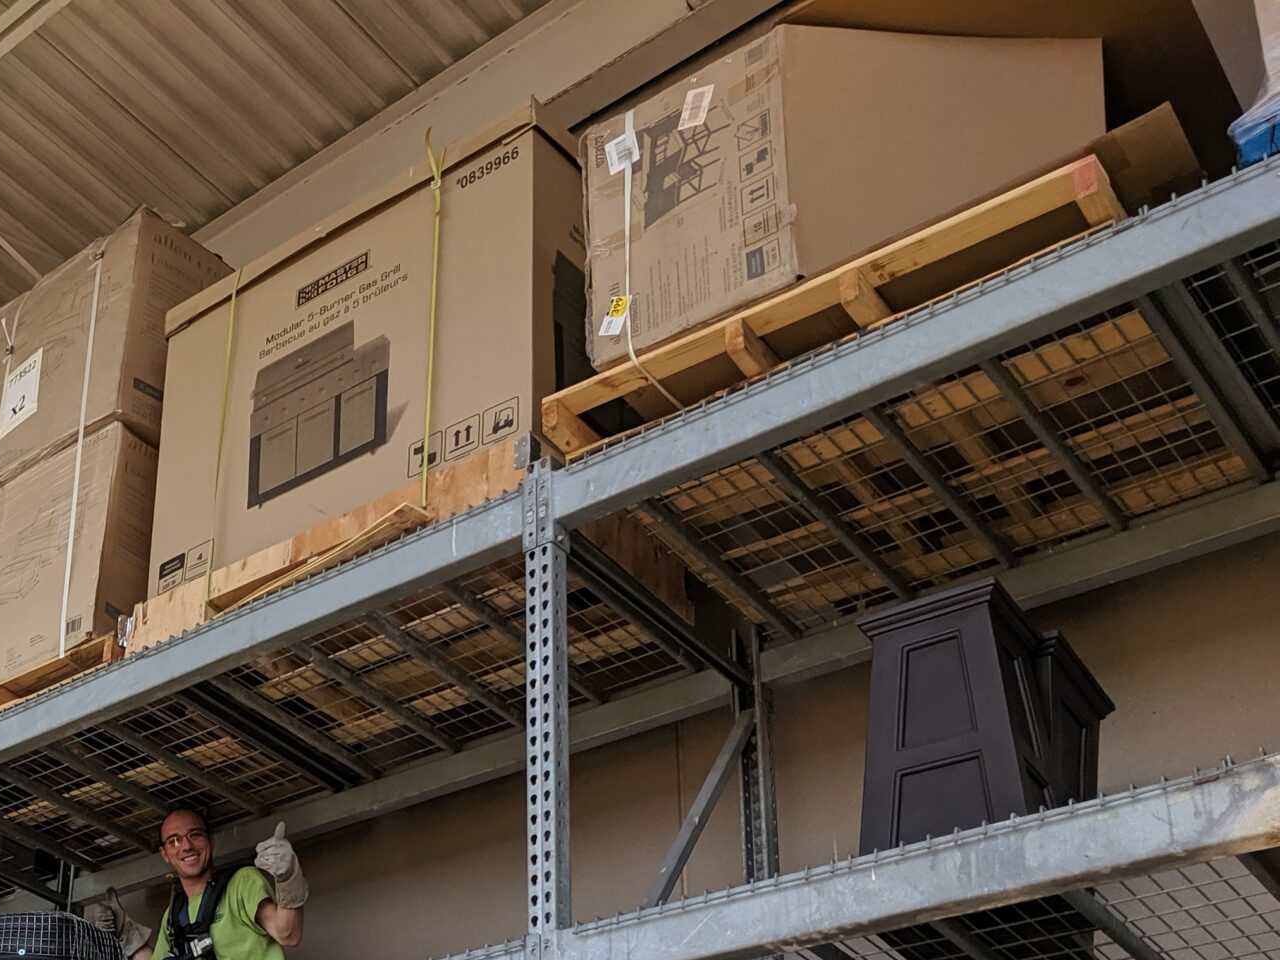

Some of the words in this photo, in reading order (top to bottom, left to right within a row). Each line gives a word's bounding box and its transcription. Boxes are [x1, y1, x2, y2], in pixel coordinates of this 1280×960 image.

[318, 254, 367, 287] MASTER
[318, 264, 367, 294] FORGE
[258, 329, 306, 360] Barbecue
[308, 321, 321, 333] au
[322, 310, 341, 326] gaz
[352, 299, 360, 310] 5
[362, 273, 408, 304] brûleurs
[265, 318, 305, 346] Modular
[307, 290, 356, 322] 5-Burner
[358, 278, 378, 294] Gas
[380, 263, 401, 281] Grill
